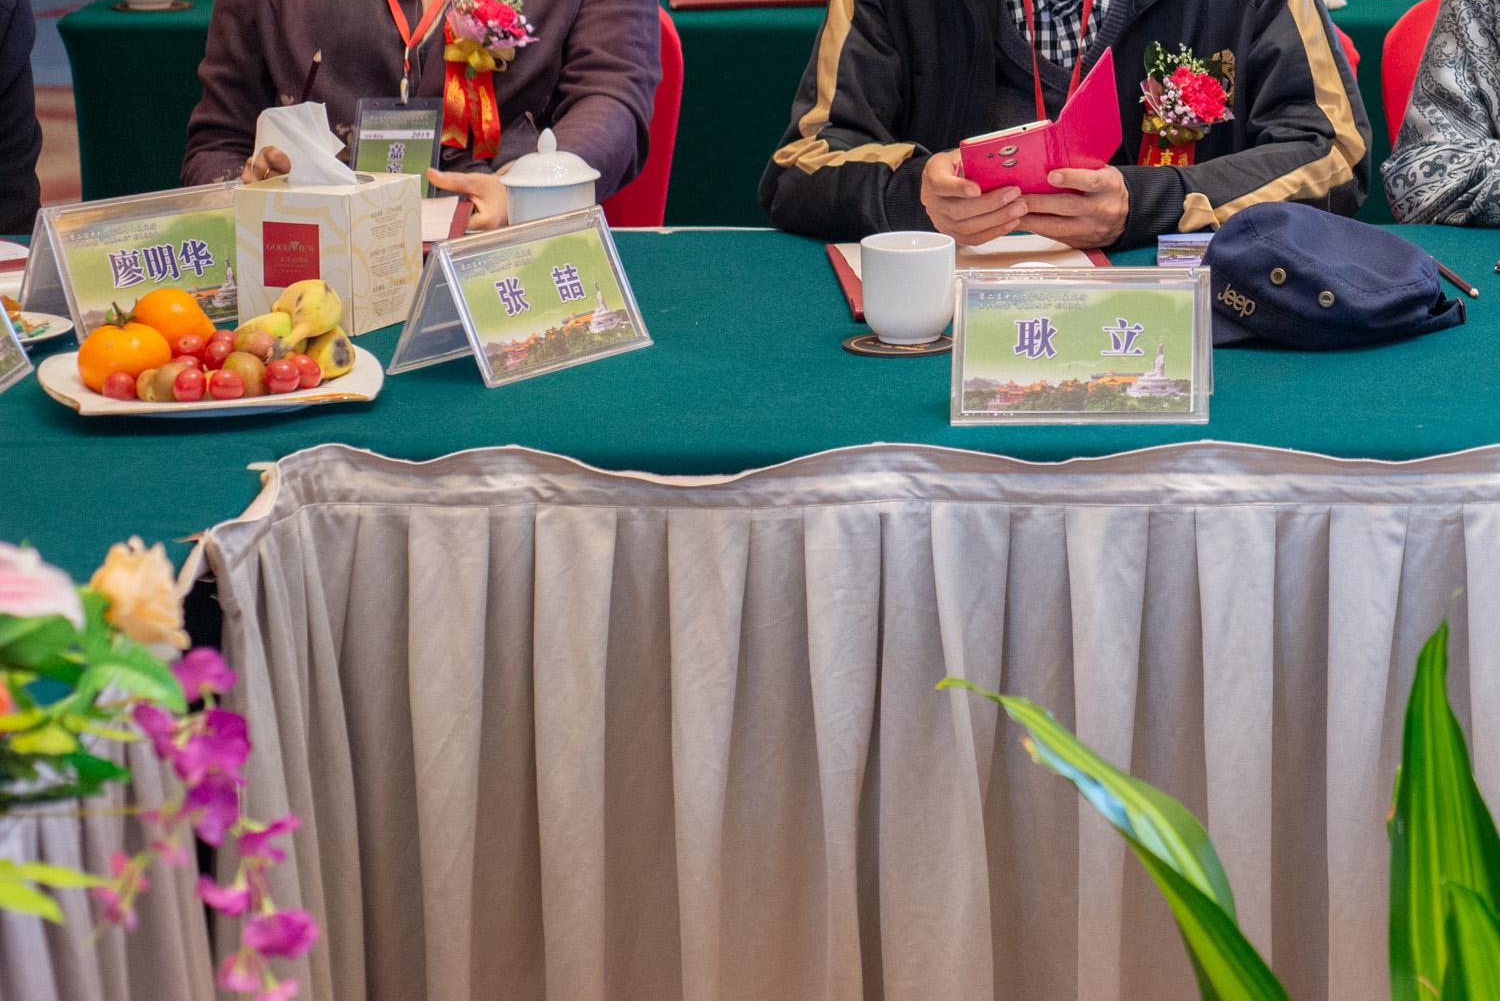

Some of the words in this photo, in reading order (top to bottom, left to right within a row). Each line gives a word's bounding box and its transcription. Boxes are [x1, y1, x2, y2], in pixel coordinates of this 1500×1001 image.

[108, 239, 215, 289] 廖明华
[1217, 283, 1256, 318] Jeep
